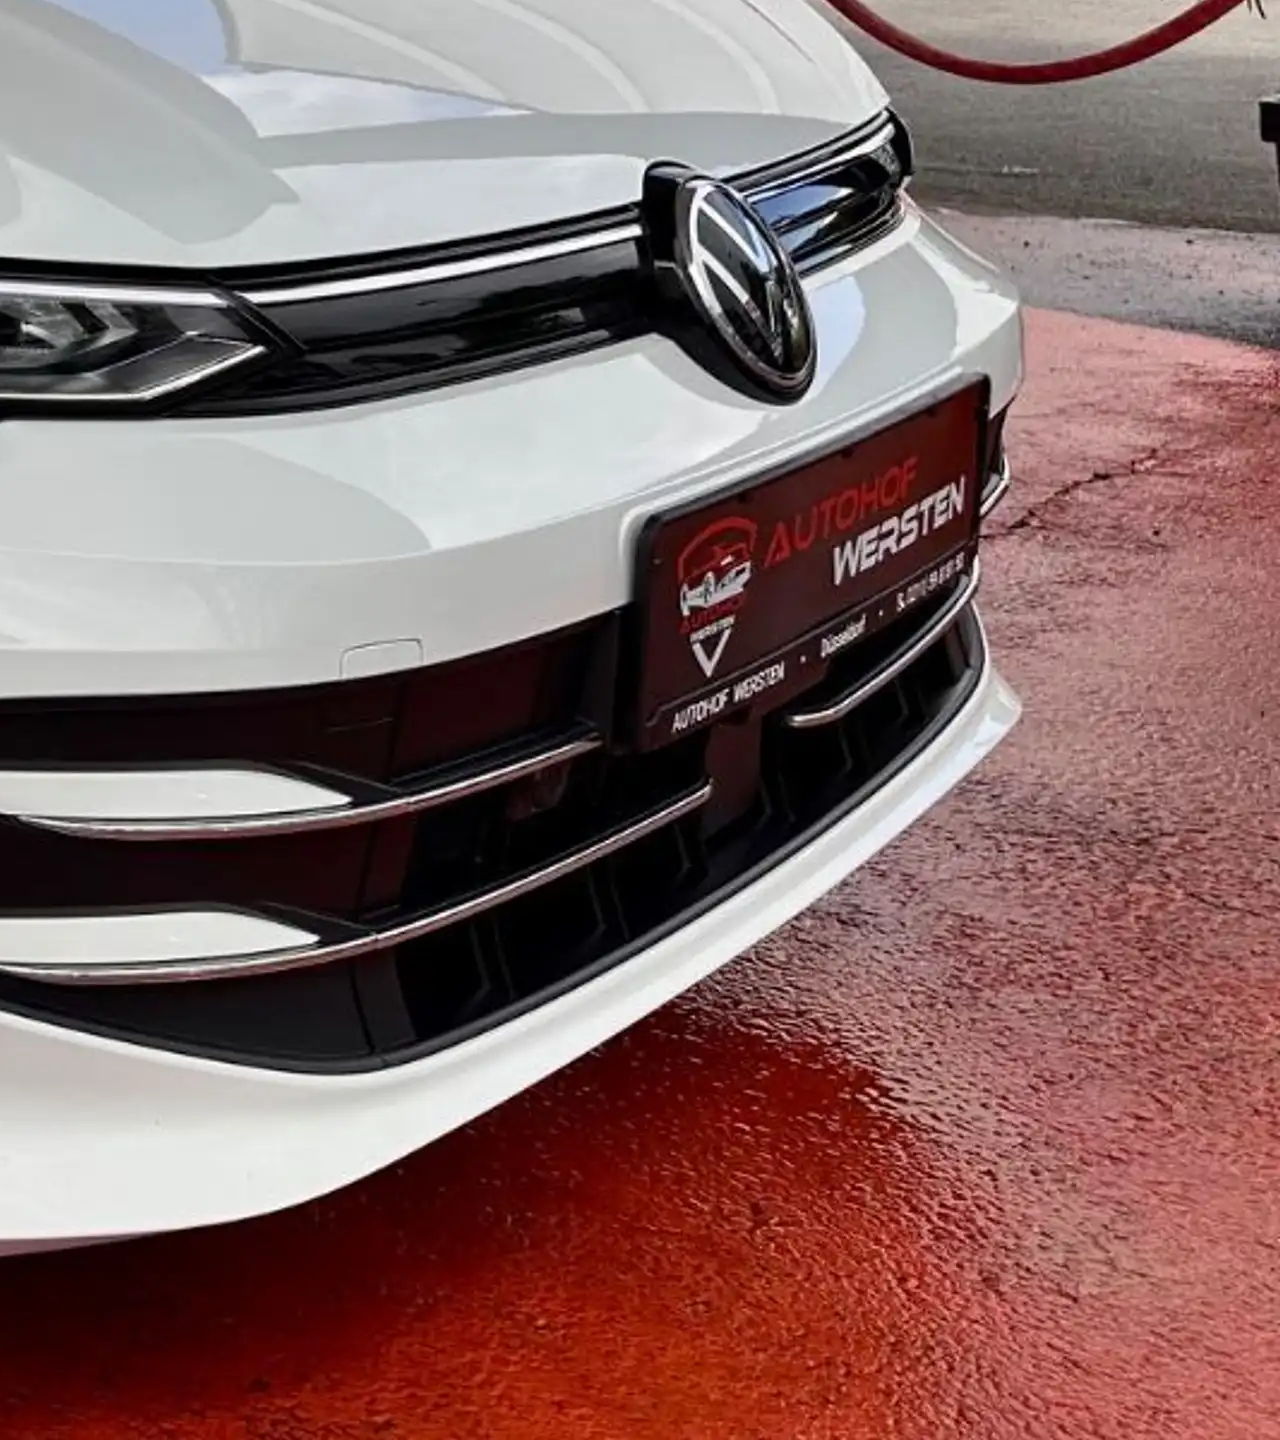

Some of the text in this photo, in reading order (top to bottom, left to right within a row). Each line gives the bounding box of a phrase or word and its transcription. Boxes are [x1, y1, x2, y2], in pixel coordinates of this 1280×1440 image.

[765, 458, 918, 568] AUTOHOF
[832, 475, 966, 586] WERSTEN
[671, 687, 730, 733] AUTOHOF
[733, 661, 785, 703] WERSTEN
